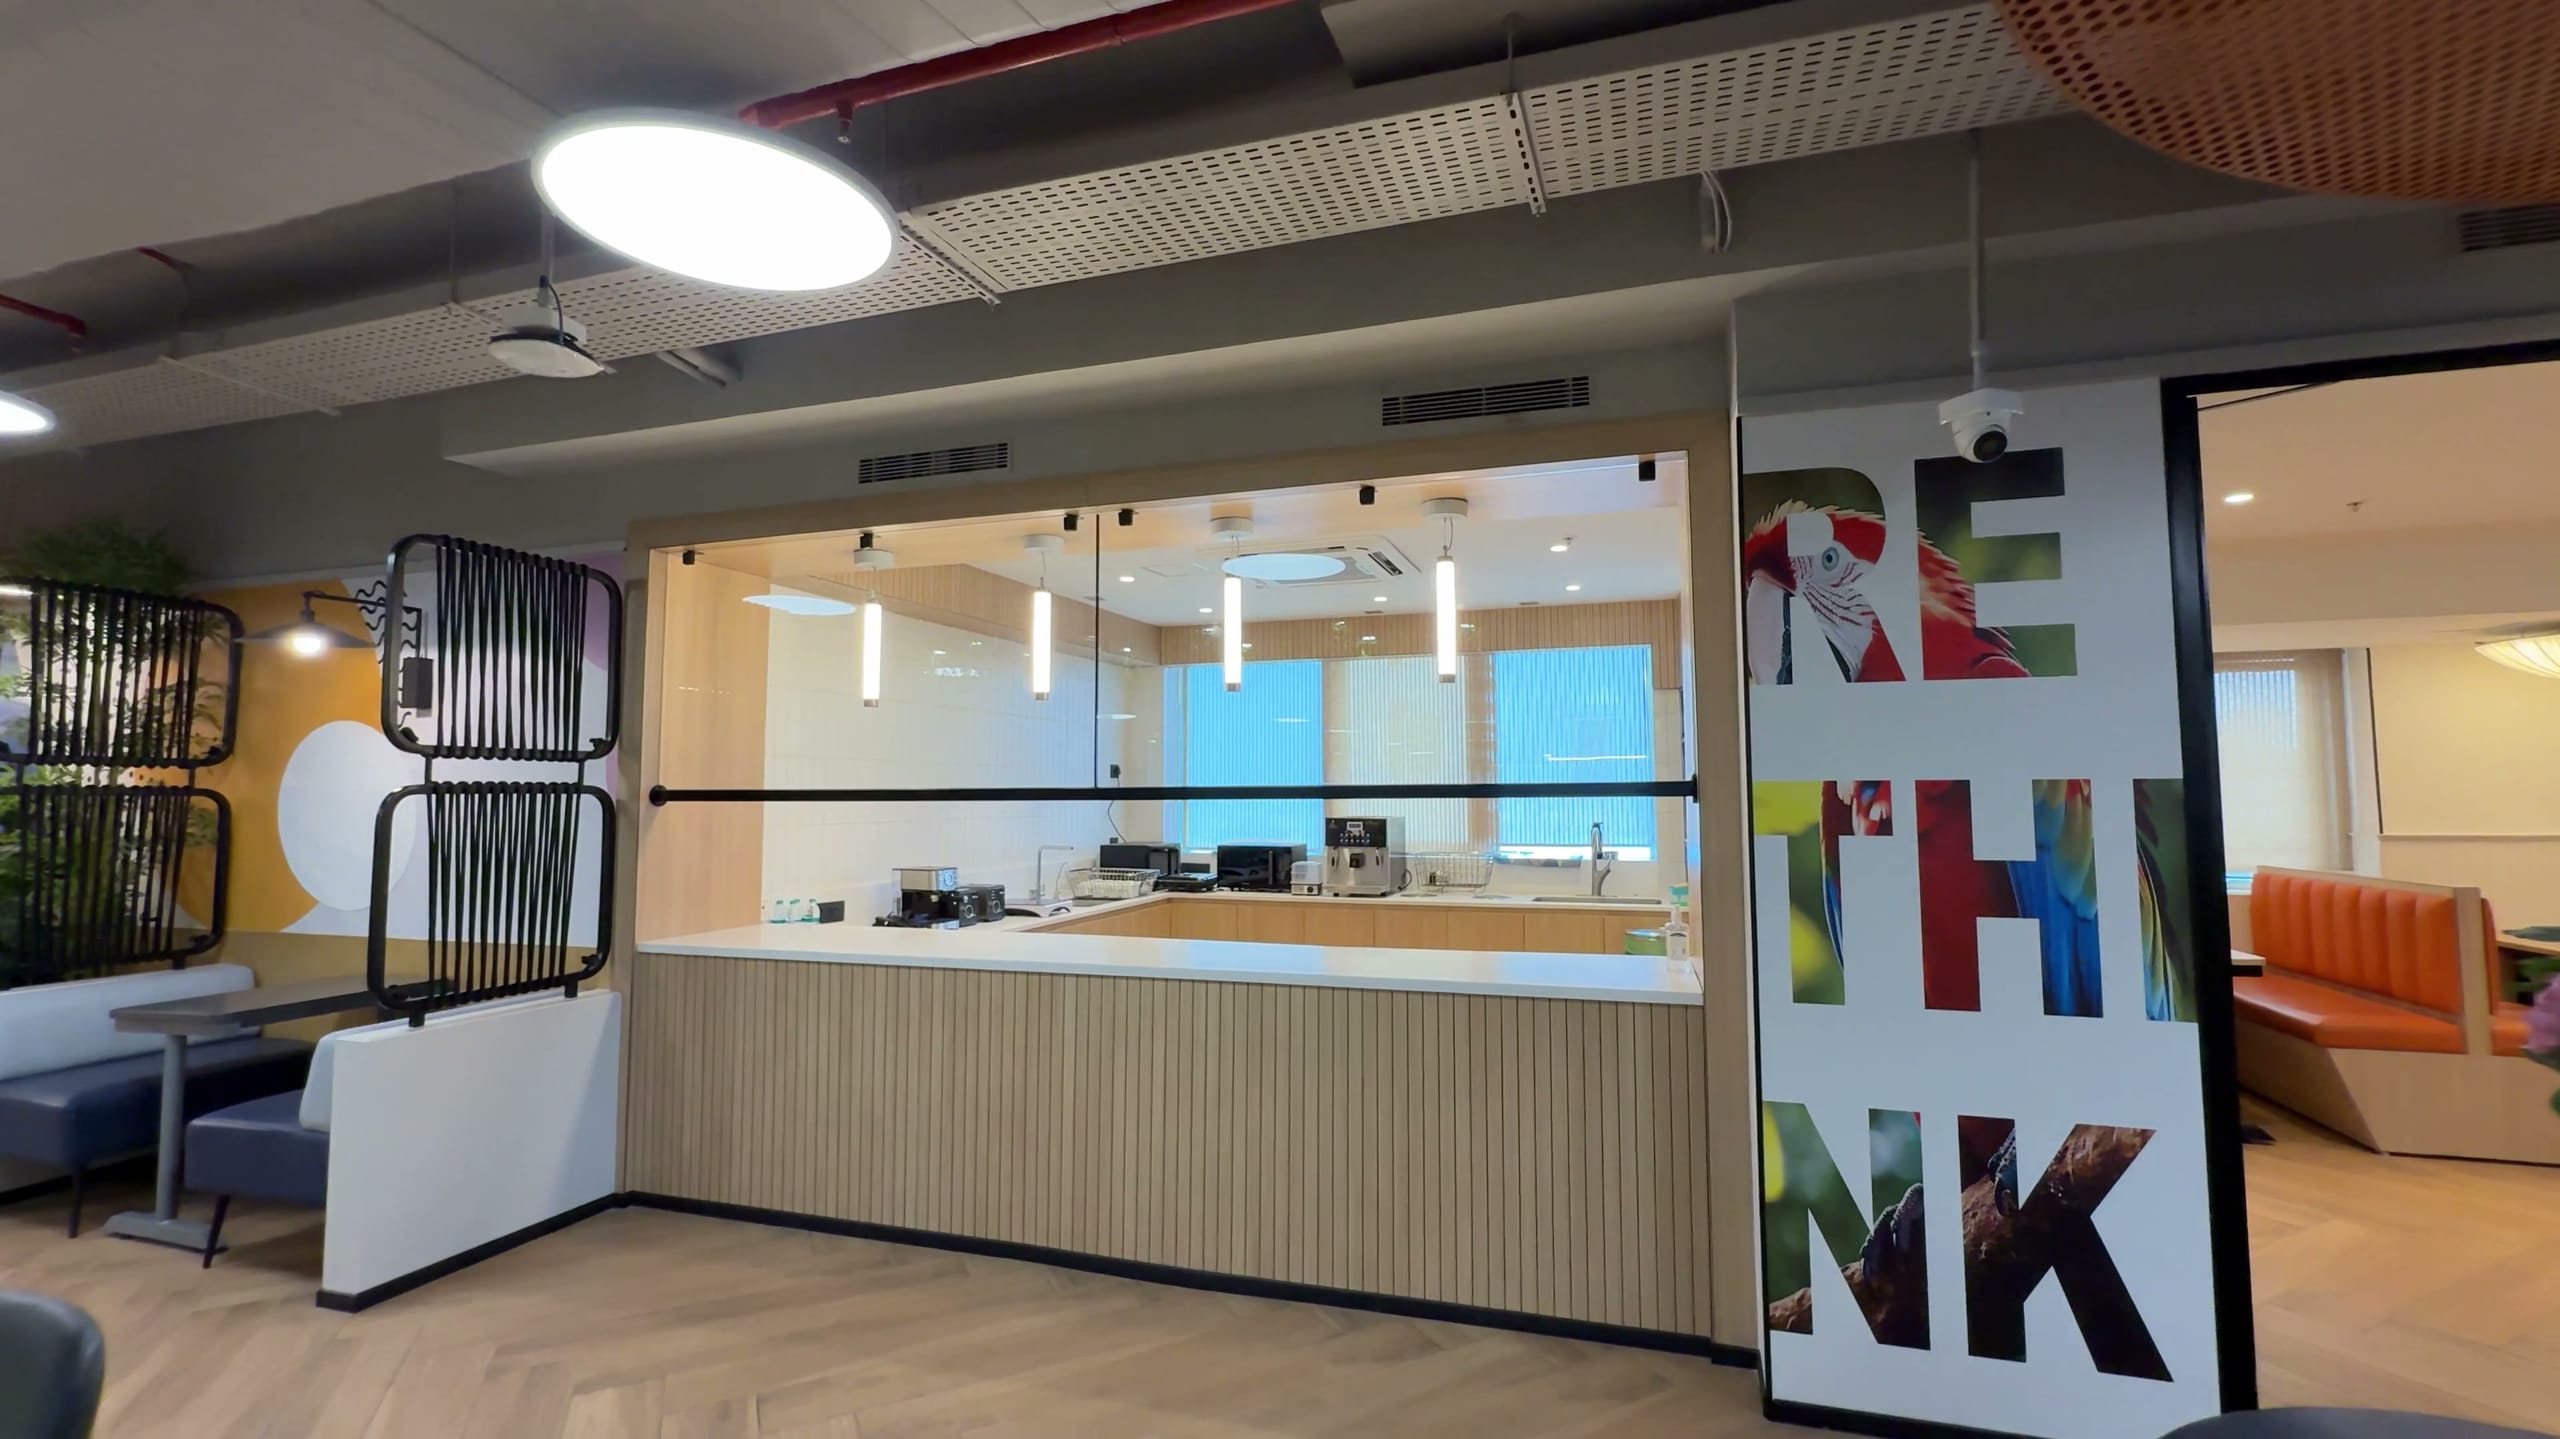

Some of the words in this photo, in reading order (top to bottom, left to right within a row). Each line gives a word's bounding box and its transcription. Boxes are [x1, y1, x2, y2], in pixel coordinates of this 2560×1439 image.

[1743, 447, 2077, 684] RE
[1753, 778, 2200, 1023] THI
[1763, 1100, 2174, 1383] NK
